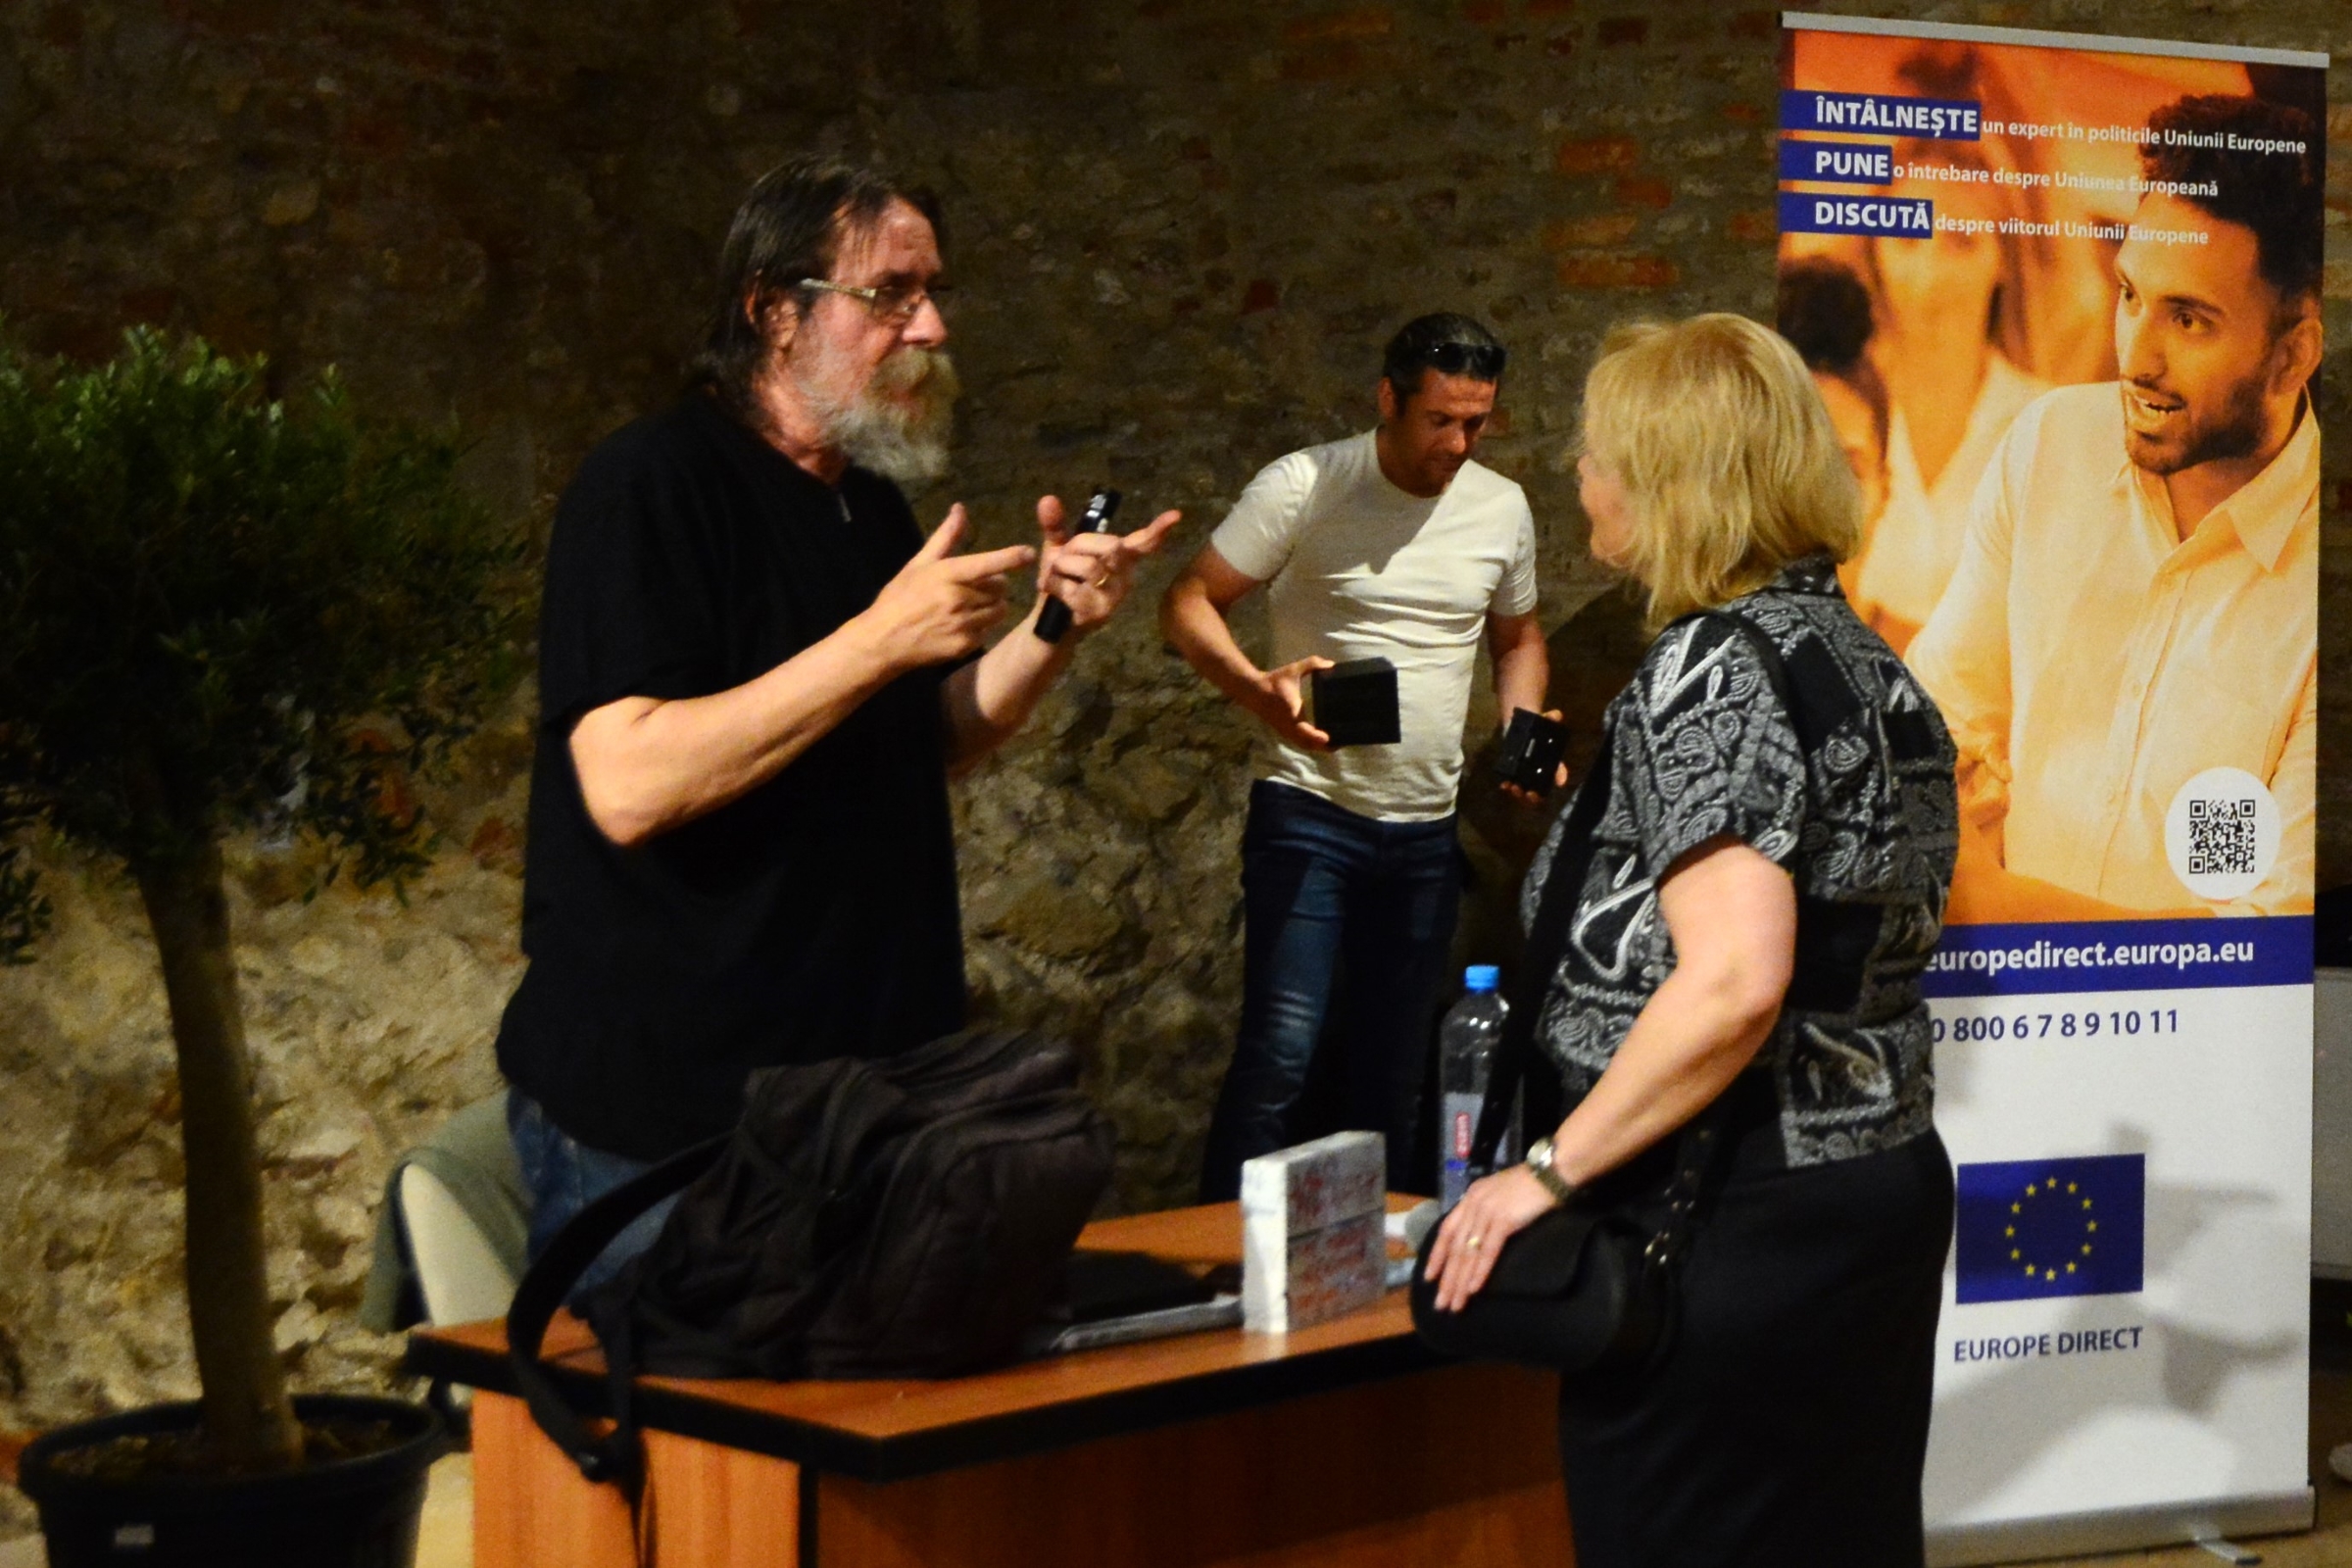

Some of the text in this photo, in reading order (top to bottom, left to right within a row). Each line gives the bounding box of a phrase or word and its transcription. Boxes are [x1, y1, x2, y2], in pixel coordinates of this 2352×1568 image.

[1983, 120, 2004, 133] un
[2009, 122, 2064, 139] expert
[2068, 122, 2082, 139] în
[2088, 124, 2160, 144] politicile
[2164, 128, 2224, 148] Uniunii
[2228, 133, 2306, 155] Europene
[1816, 150, 2219, 197] PUNE o întrebare despre Uniunea Europeană
[1815, 201, 2209, 245] DISCUTĂ despre viitorul Uniunii Europene
[1953, 1015, 2005, 1042] 800
[2109, 1009, 2141, 1035] 10
[2150, 1008, 2179, 1033] 11
[1954, 1326, 2143, 1362] EUROPE DIRECT
